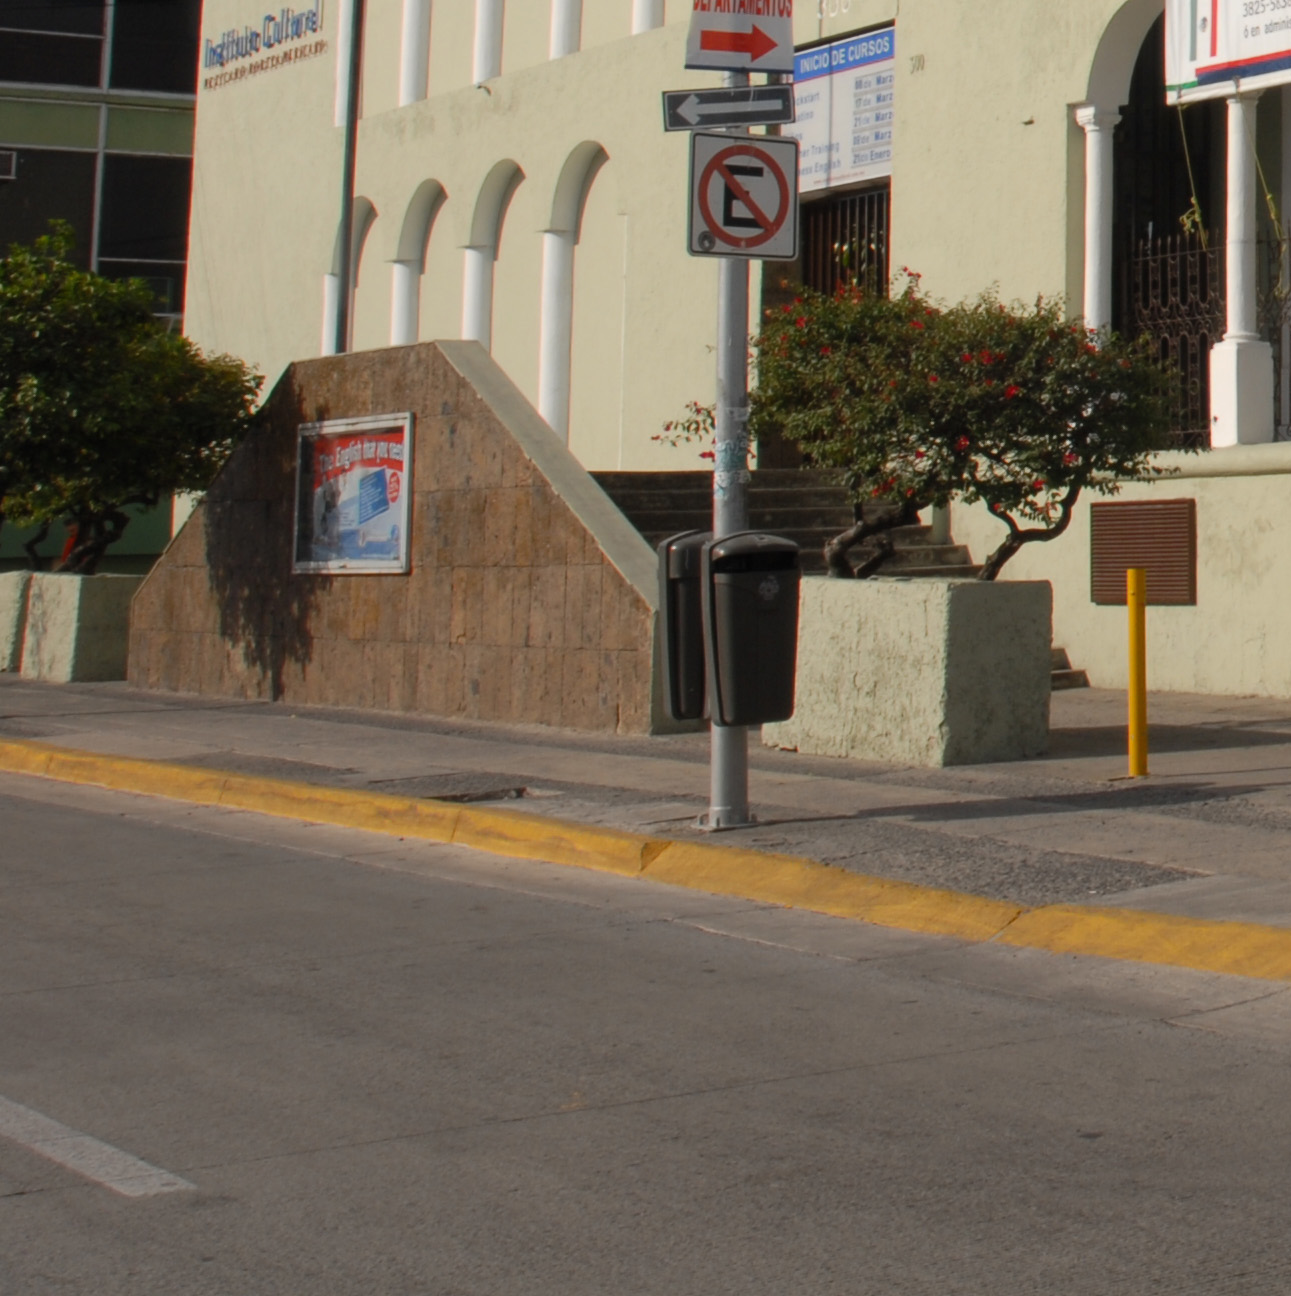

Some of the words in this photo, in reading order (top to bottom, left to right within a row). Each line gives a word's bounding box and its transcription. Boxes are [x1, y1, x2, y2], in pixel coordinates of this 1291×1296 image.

[205, 26, 261, 68] Instituto
[1251, 24, 1261, 36] en
[800, 53, 829, 74] INICIO
[832, 49, 846, 65] DE
[848, 37, 890, 61] CURSOS
[797, 92, 820, 106] ckstart
[724, 164, 765, 229] E
